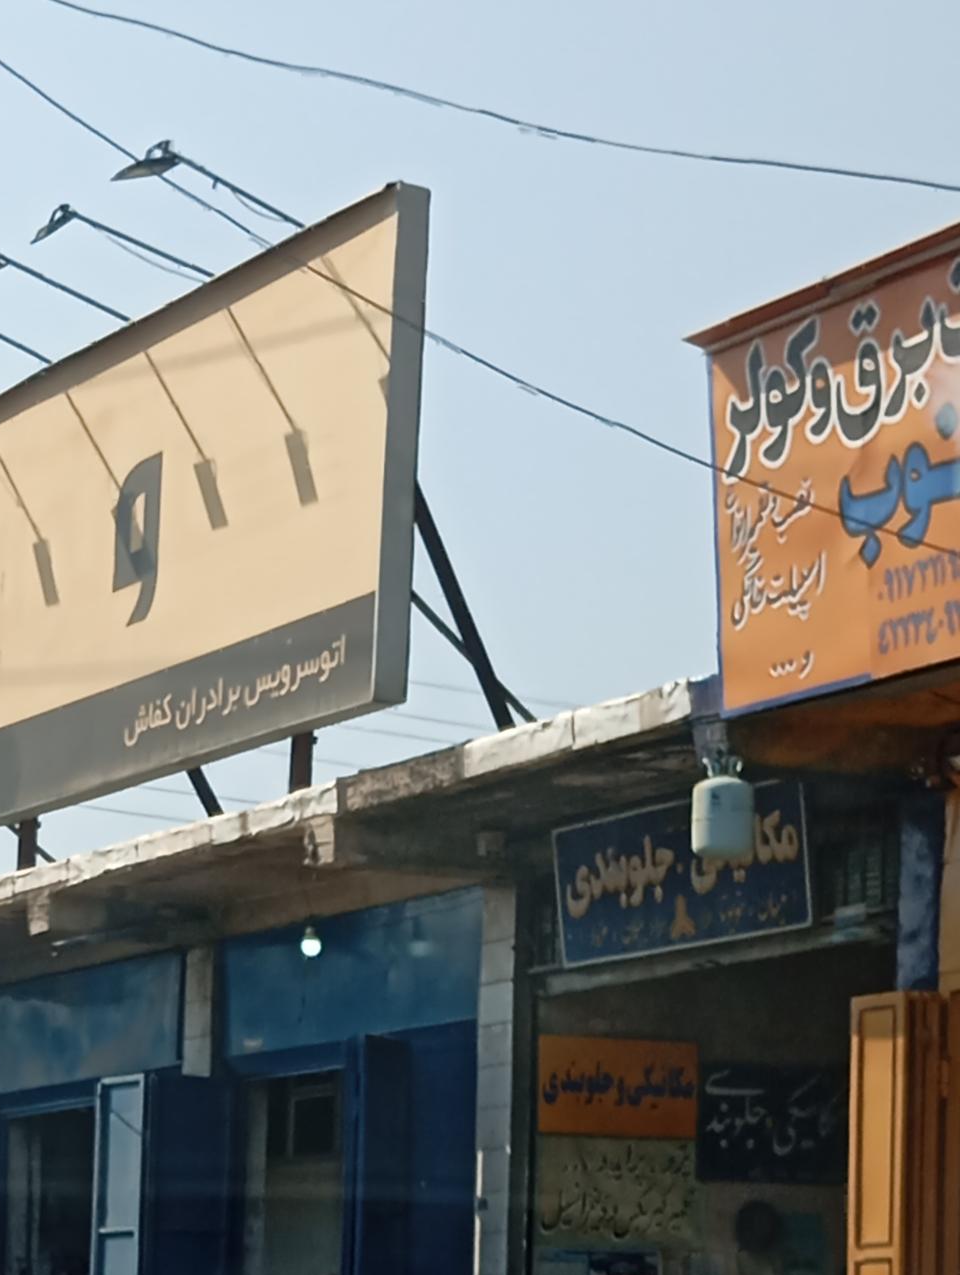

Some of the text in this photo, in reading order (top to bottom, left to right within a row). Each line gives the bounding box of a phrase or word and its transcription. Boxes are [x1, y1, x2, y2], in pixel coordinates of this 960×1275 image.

[720, 316, 821, 485] کولر
[834, 294, 939, 450] برق
[836, 400, 960, 570] نوب
[174, 677, 242, 730] برادران
[565, 834, 675, 919] جلوبندی
[543, 1059, 614, 1105] جلوبندی
